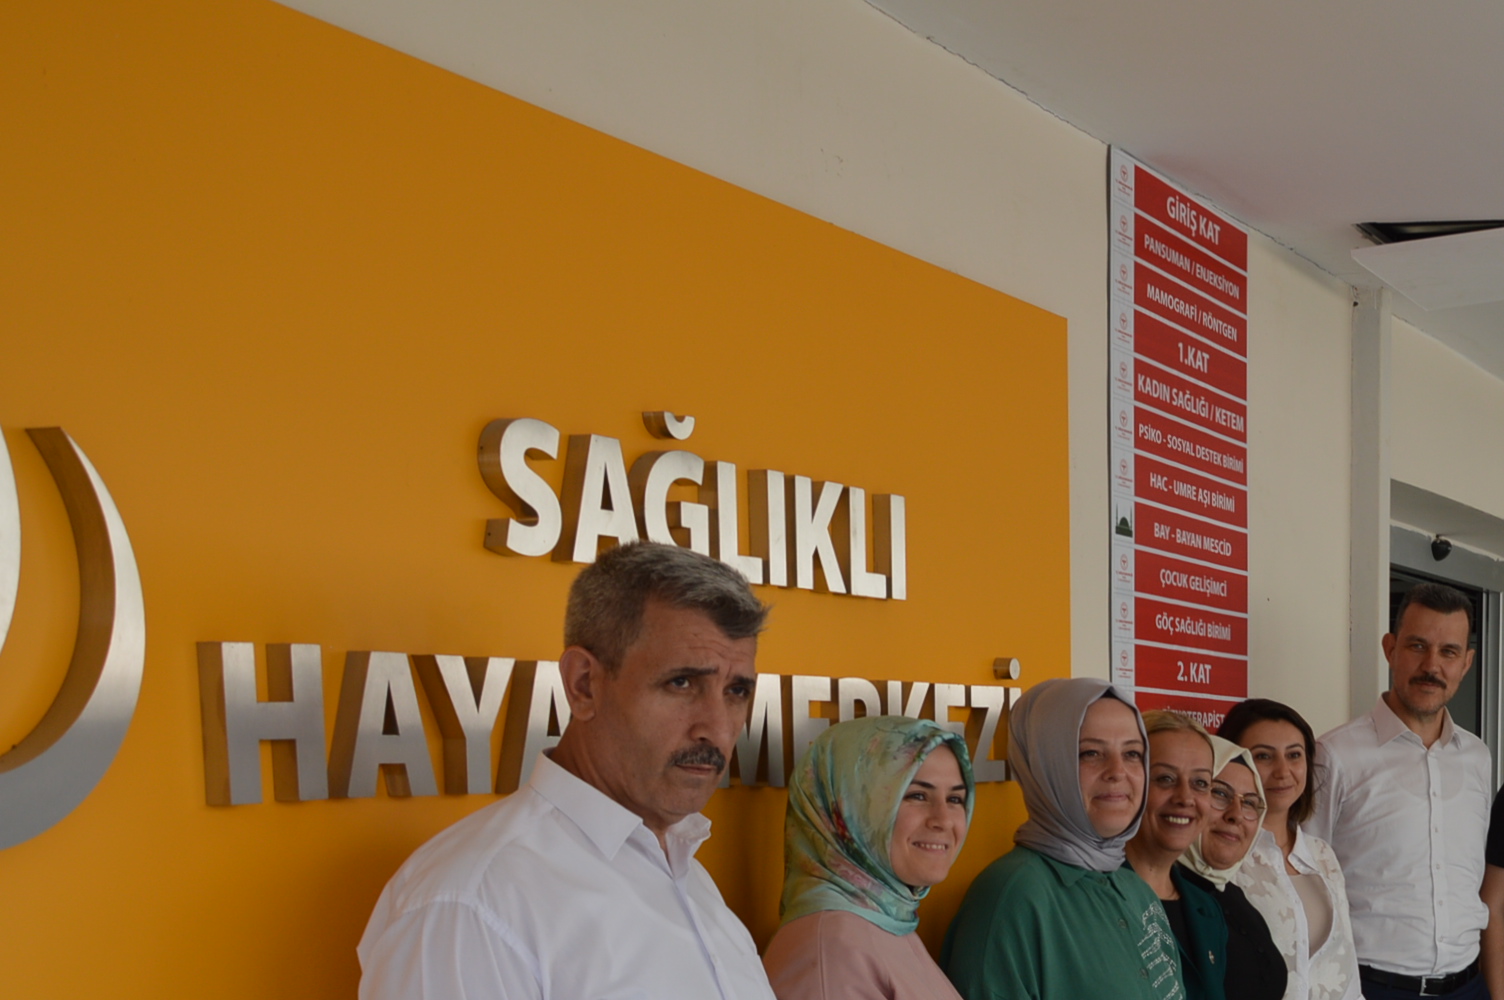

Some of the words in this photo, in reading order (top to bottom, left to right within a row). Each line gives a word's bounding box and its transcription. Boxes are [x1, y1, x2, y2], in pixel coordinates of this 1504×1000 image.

[1166, 195, 1197, 237] GİRİŞ
[1199, 215, 1221, 245] KAT
[1144, 234, 1190, 273] PANSUMAN
[1196, 263, 1239, 299] ENJEKSİYON
[1147, 283, 1197, 322] MAMOGRAFİ
[1202, 310, 1237, 342] RÖNTGEN
[1178, 342, 1210, 373] 1.KAT
[1138, 373, 1170, 403] KADIN
[1172, 388, 1209, 419] SAĞLIĞI
[1215, 406, 1244, 433] KETEM
[1139, 423, 1162, 444] PSİKO
[1167, 434, 1195, 457] SOSYAL
[1196, 444, 1222, 466] DESTEK
[1222, 454, 1244, 474] BİRİMİ
[496, 410, 907, 600] SAĞLIKLI
[1150, 472, 1168, 492] HAC
[1173, 480, 1197, 501] UMRE
[1197, 488, 1210, 508] AŞI
[1211, 491, 1235, 513] BİRİMİ
[1154, 522, 1171, 540] BAY
[1176, 528, 1202, 549] BAYAN
[1203, 536, 1232, 556] MESCİD
[1160, 568, 1188, 588] ÇOCUK
[1189, 575, 1227, 597] GELİŞİMCİ
[1155, 612, 1174, 635] GÖÇ
[1175, 616, 1206, 637] SAĞLIĞI
[1207, 621, 1231, 641] BİRİMİ
[1177, 661, 1188, 682] 2.
[1190, 662, 1212, 684] KAT
[215, 641, 573, 805] HAYA
[1162, 706, 1226, 729] TERAPİST
